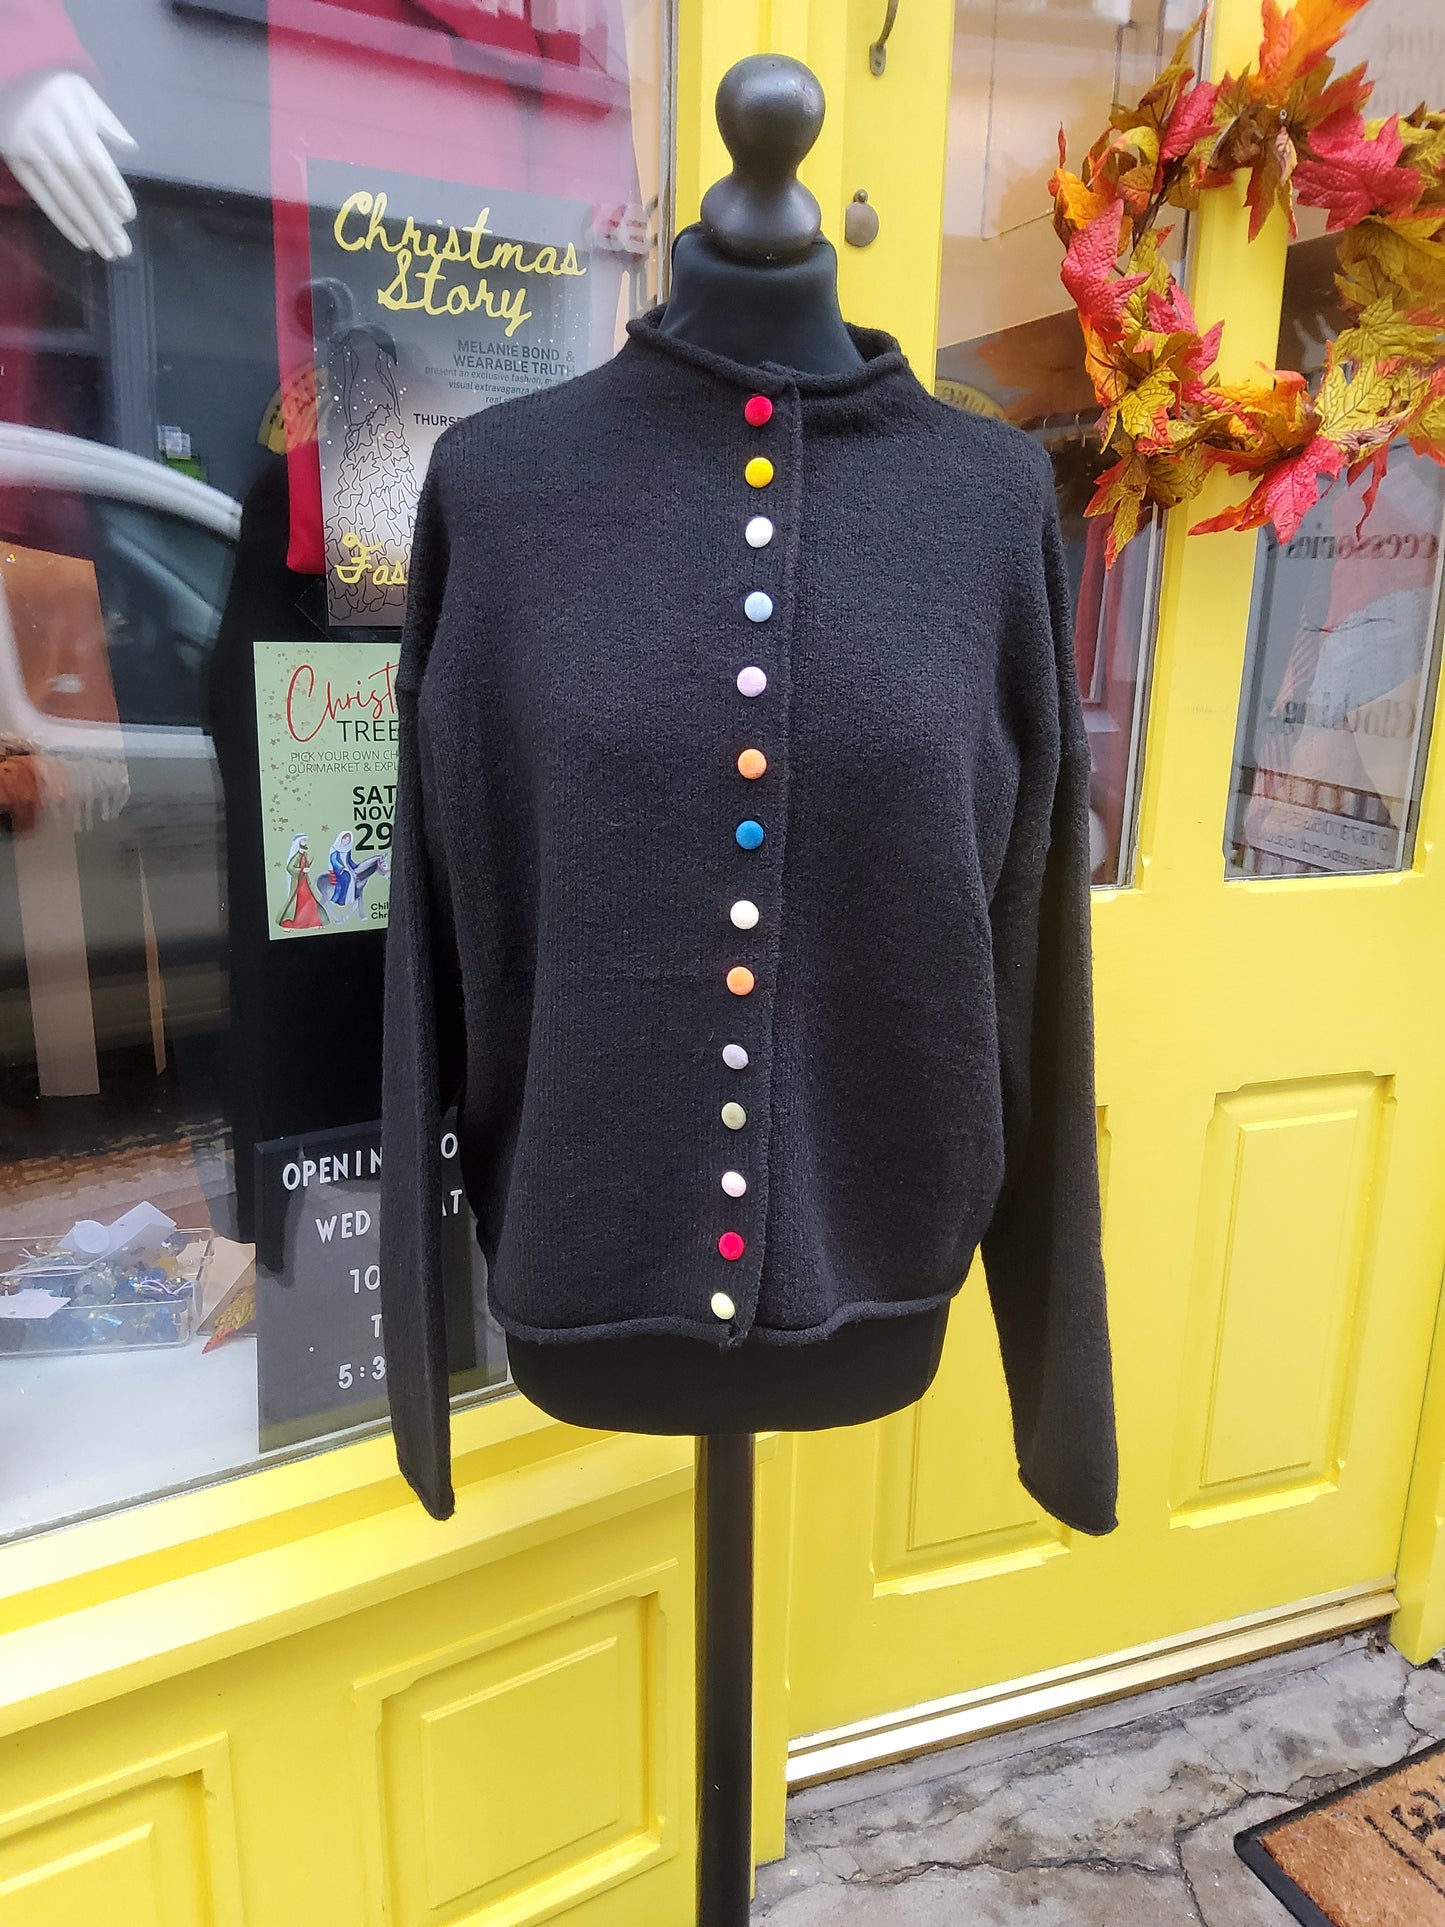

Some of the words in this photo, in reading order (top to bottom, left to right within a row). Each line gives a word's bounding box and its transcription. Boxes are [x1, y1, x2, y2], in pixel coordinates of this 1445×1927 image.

[334, 191, 587, 276] Christmas
[377, 249, 532, 337] Story
[457, 339, 519, 357] MELANIE
[522, 346, 560, 361] BOND
[566, 351, 575, 362] &
[425, 366, 457, 377] present
[471, 371, 509, 382] exclusive
[453, 354, 529, 373] WEARABLE
[531, 361, 575, 377] TRUTH
[449, 381, 474, 390] visual
[475, 383, 530, 395] extravaganza
[334, 532, 407, 586] Fas
[287, 661, 398, 742] Christ
[336, 719, 398, 742] TREE
[291, 752, 315, 762] PICK
[317, 751, 349, 761] YOUR
[352, 750, 380, 760] OWN
[288, 764, 313, 774] OUR
[316, 762, 360, 773] MARKET
[363, 762, 371, 771] &
[352, 785, 396, 805] SAT
[353, 806, 394, 821] NOV
[355, 822, 393, 850] 29
[371, 902, 388, 911] Chil
[371, 911, 387, 919] Chr
[315, 1210, 370, 1243] WED
[349, 1265, 380, 1293] 10
